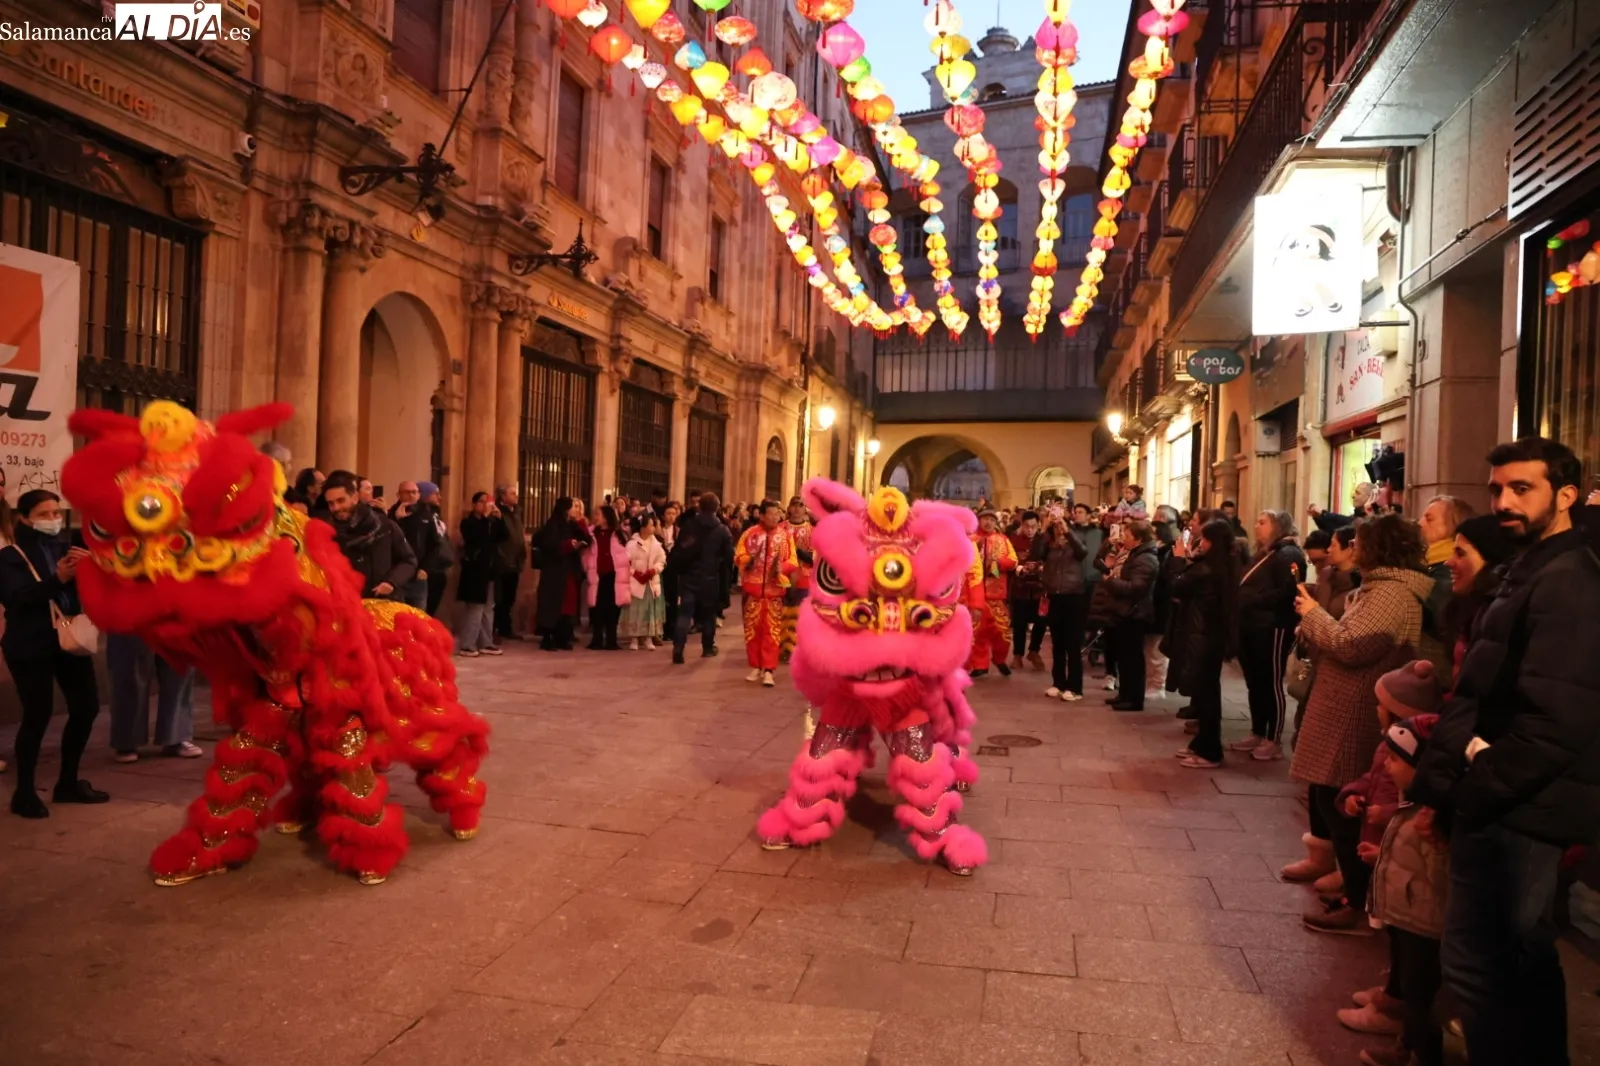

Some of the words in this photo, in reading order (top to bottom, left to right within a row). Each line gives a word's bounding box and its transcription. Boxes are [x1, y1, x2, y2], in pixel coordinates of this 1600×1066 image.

[23, 42, 156, 121] Santander
[1190, 357, 1226, 369] copas
[1205, 366, 1242, 375] rotas
[24, 456, 45, 468] bajo
